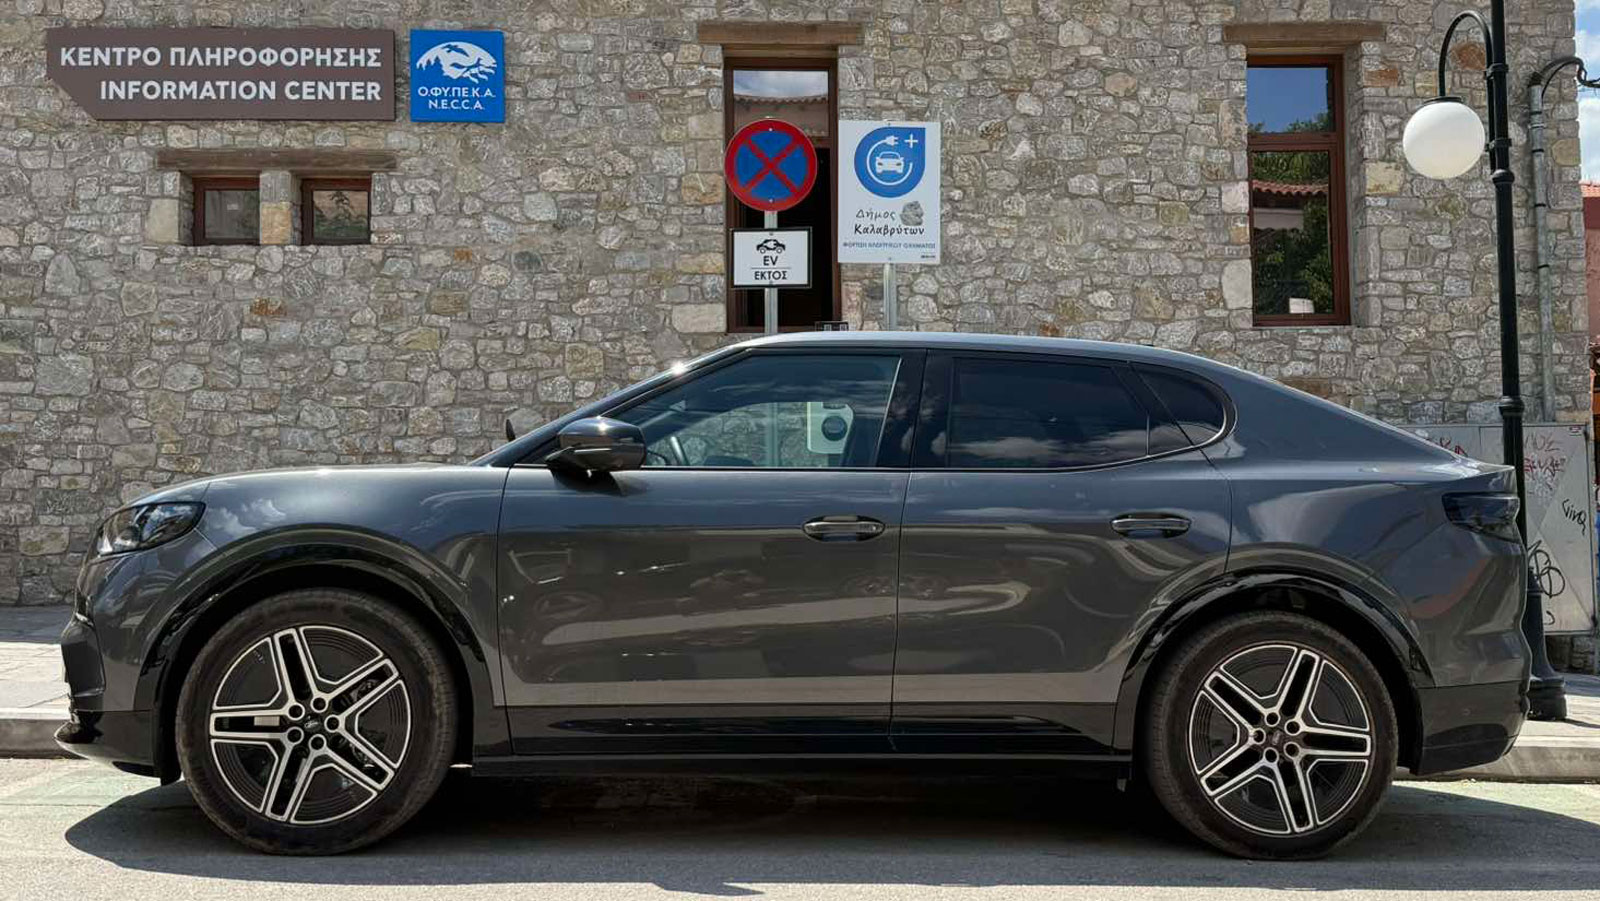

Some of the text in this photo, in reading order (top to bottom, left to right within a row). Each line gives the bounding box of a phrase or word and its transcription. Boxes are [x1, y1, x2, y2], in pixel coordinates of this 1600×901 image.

[60, 46, 382, 68] ΚΕΝΤΡΟ ΠΛΗΡΟΦΟΡΗΣΗΣ
[100, 80, 382, 101] INFORMATION CENTER
[855, 207, 896, 221] Δήμος
[854, 223, 925, 236] Καλαβρύτων
[763, 255, 779, 266] EV
[754, 270, 787, 281] ΕΚΤΟΣ
